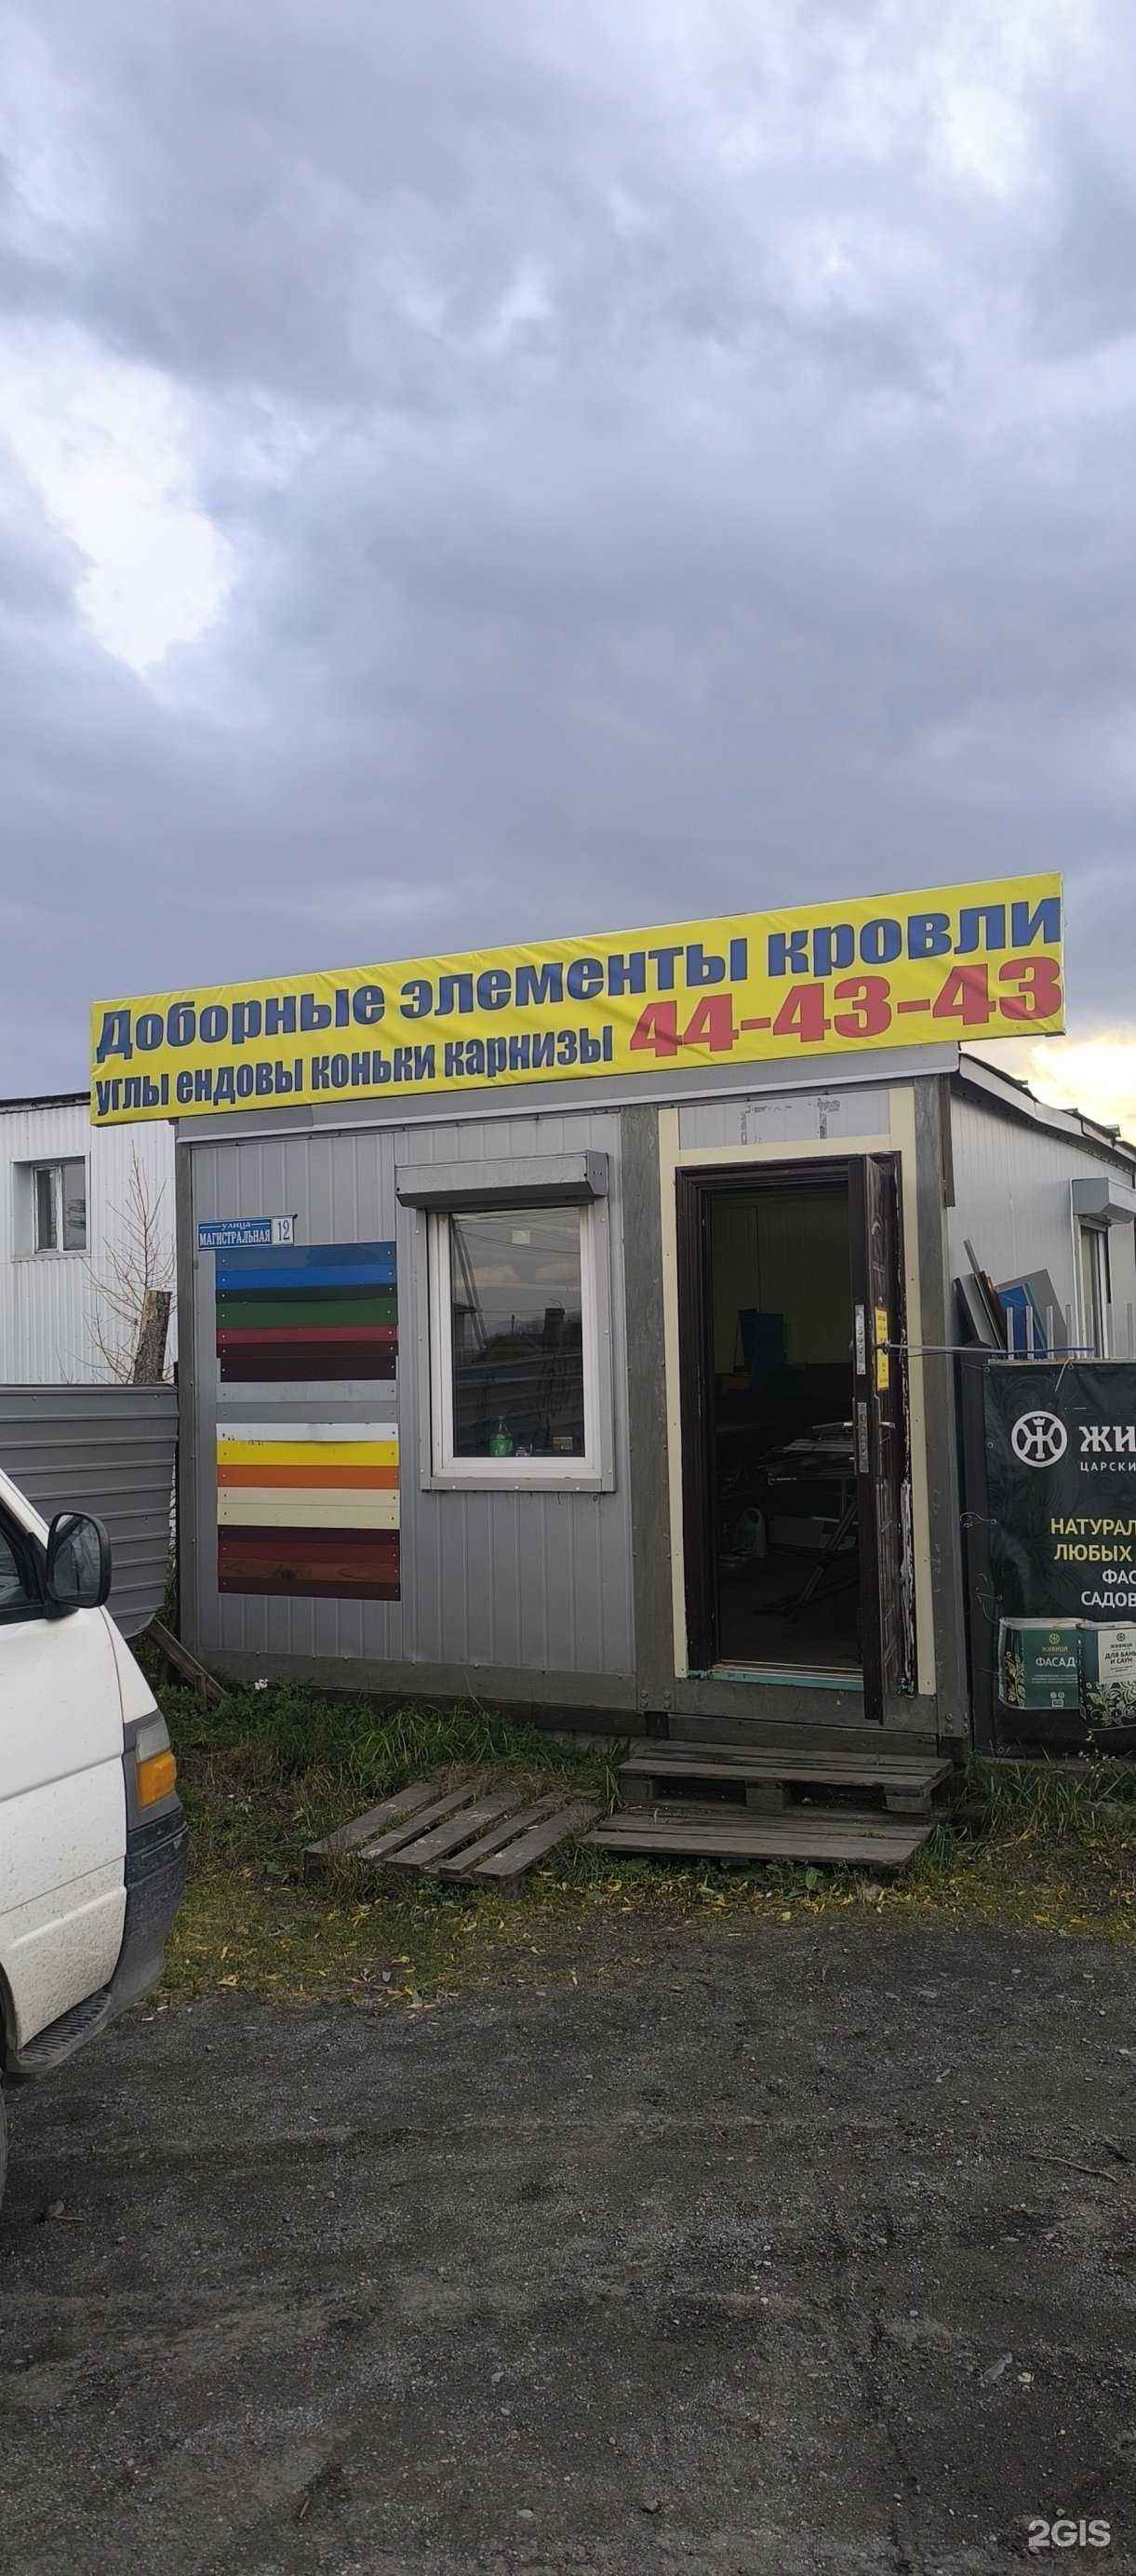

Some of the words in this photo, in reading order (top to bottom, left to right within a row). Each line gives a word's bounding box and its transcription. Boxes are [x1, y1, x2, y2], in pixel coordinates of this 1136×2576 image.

[96, 983, 385, 1064] Доборные
[400, 937, 748, 1019] элементы
[768, 896, 1062, 977] кровли
[629, 955, 1062, 1058] 44-43-43
[95, 1073, 169, 1116] углы
[176, 1058, 303, 1106] ендовы
[311, 1043, 436, 1090] коньки
[445, 1025, 613, 1078] карнизы
[199, 1228, 271, 1246] МАГИСТРАЛЬНАЯ
[277, 1219, 290, 1241] 12
[1078, 1426, 1136, 1452] ЖИ
[1080, 1461, 1136, 1472] ЦАРСКИ
[1053, 1543, 1133, 1563] ЛЮБЫХ
[1036, 1657, 1076, 1669] ФАСАД
